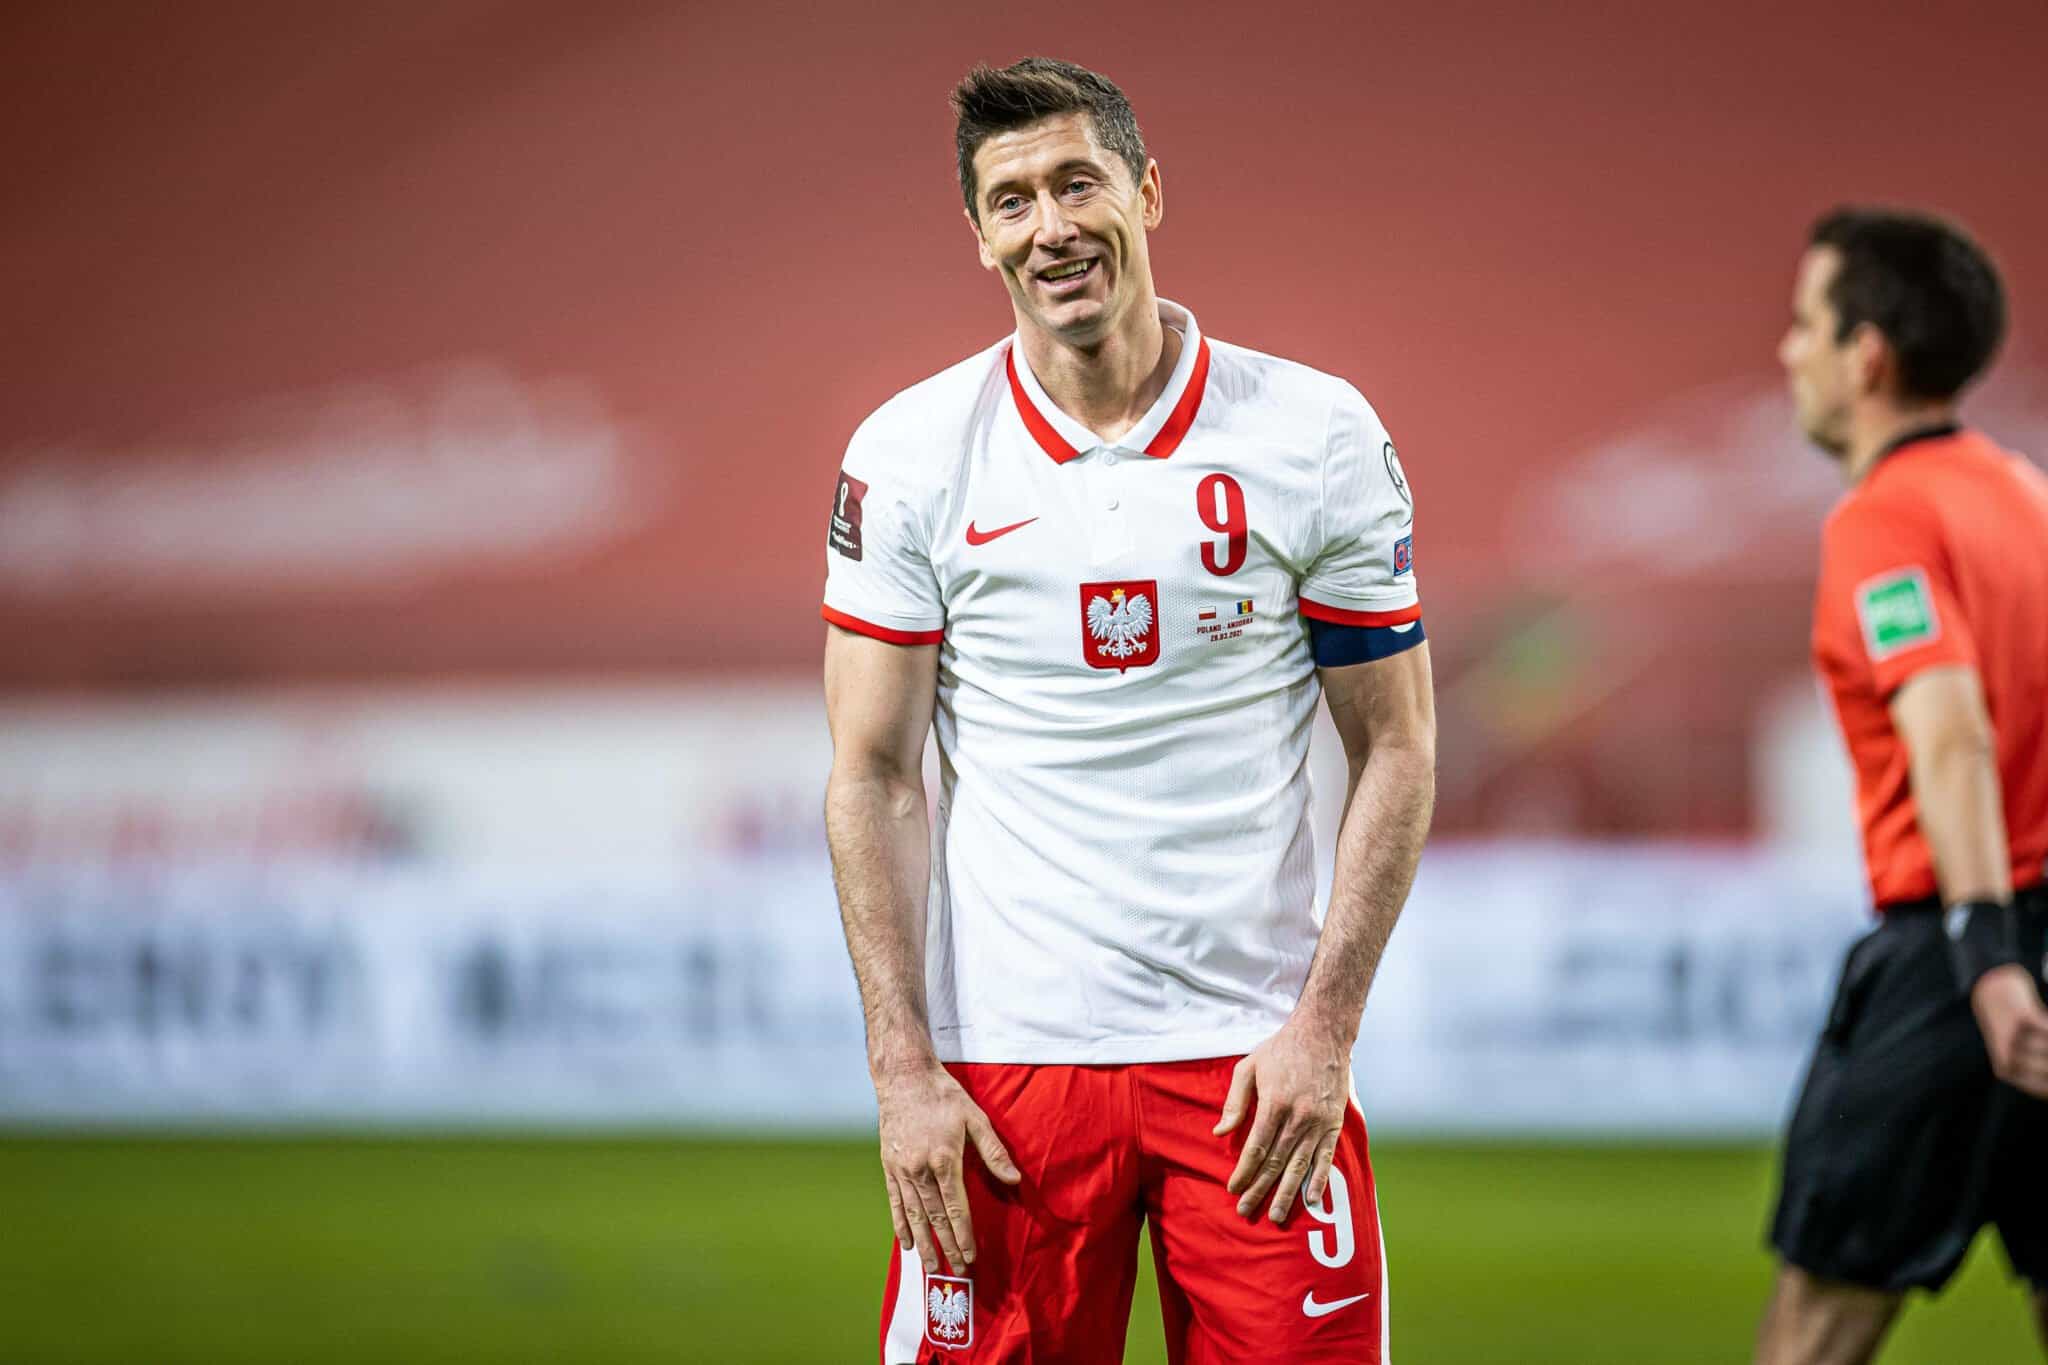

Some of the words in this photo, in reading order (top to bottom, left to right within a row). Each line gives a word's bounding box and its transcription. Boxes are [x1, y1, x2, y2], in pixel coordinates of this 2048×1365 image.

[1196, 473, 1248, 576] 9
[1197, 624, 1221, 634] POLAND
[1227, 617, 1253, 629] ANDORRA
[1301, 1163, 1355, 1268] 9
